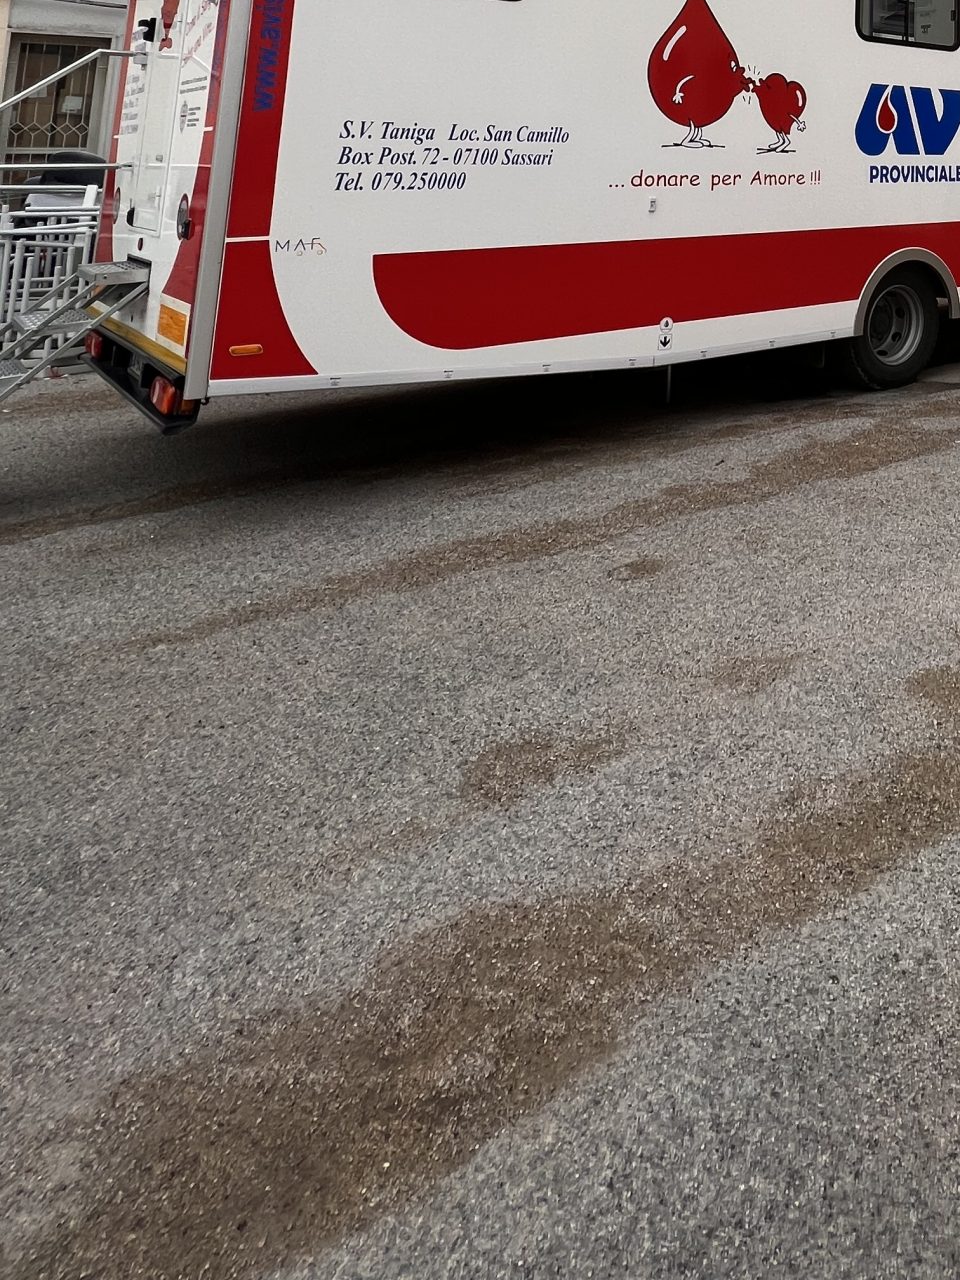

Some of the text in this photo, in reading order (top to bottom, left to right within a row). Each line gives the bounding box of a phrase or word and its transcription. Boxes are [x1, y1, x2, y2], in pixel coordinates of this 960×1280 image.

[339, 120, 570, 145] S.V. Taniga Loc. San Camillo
[337, 146, 374, 166] Box
[378, 147, 417, 166] Post.
[421, 148, 441, 166] 72
[453, 148, 498, 166] 07100
[501, 148, 554, 166] Sassari
[334, 172, 467, 191] Tel. 079.250000
[710, 174, 742, 191] per
